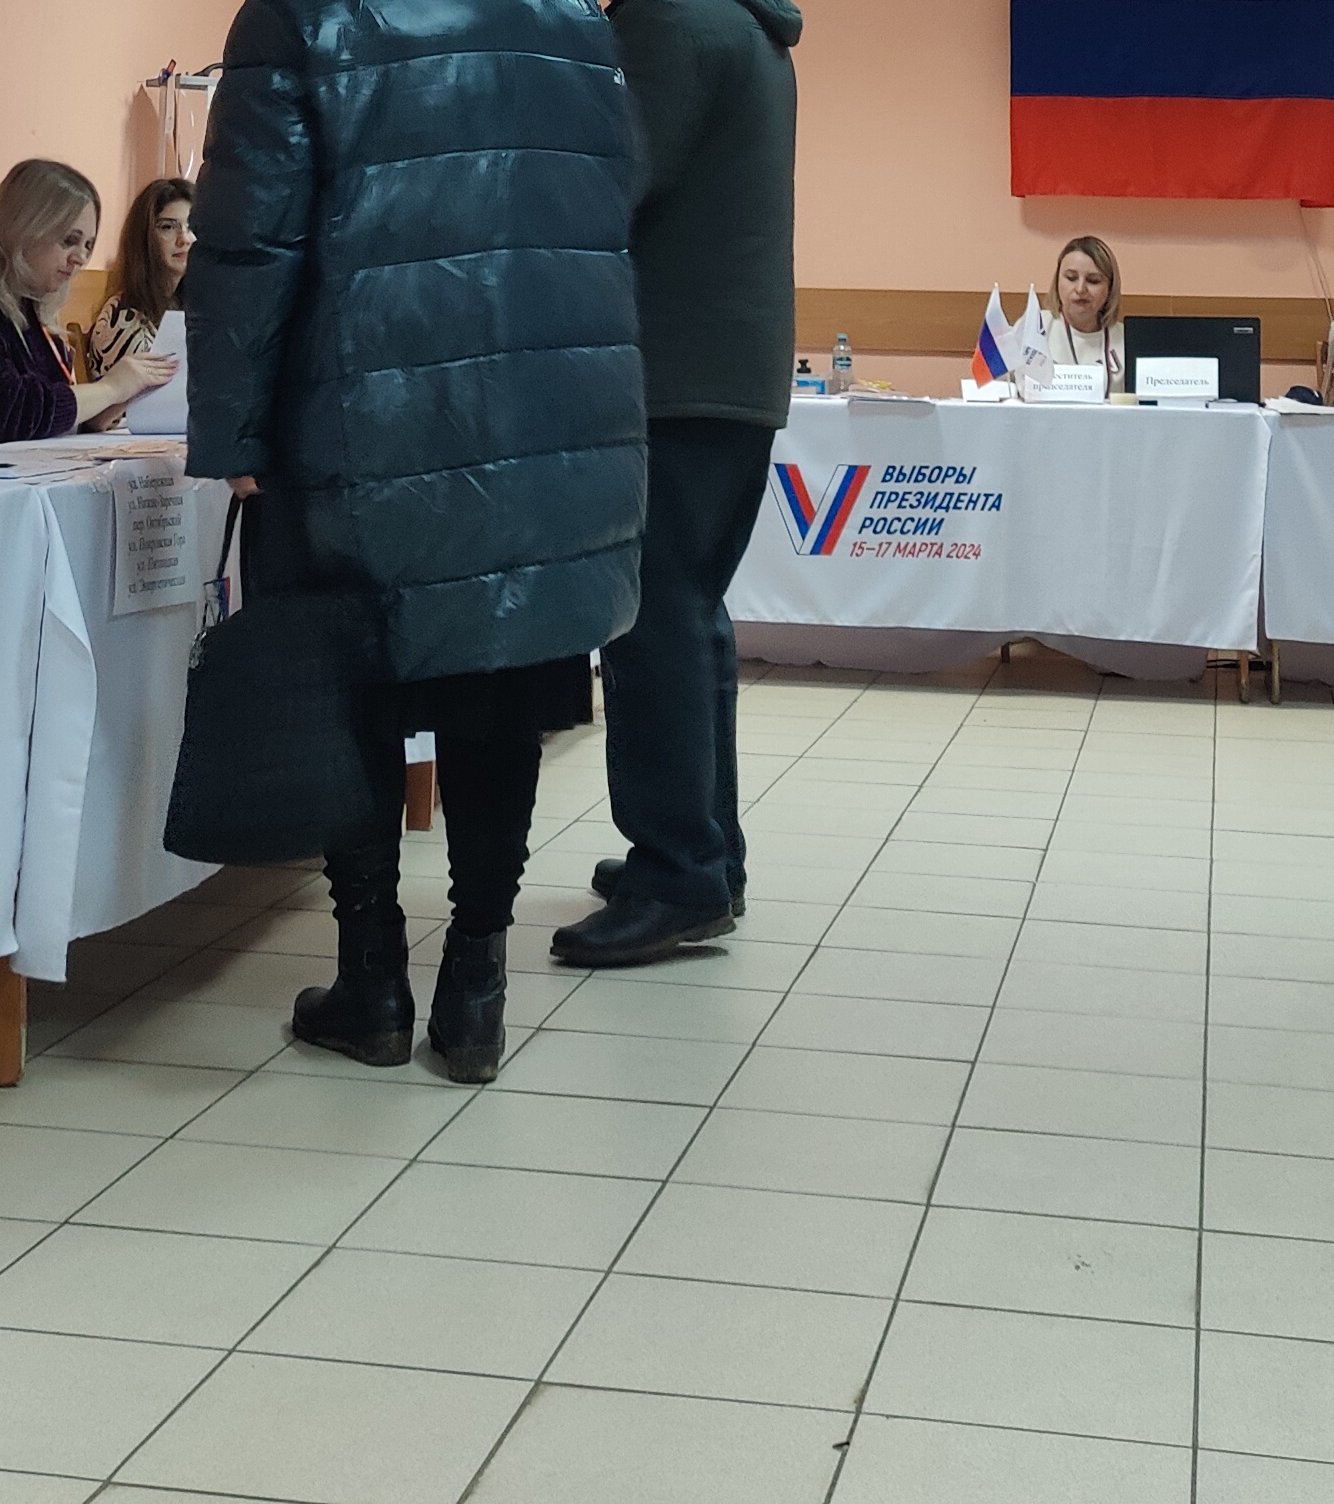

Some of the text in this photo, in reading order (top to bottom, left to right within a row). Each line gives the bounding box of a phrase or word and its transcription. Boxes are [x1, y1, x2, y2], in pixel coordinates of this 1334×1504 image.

[1145, 376, 1210, 388] Председатель
[880, 465, 977, 485] ВЫБОРЫ
[869, 490, 1003, 513] ПРЕЗИДЕНТА
[858, 516, 945, 536] РОССИИ
[892, 542, 943, 559] МАРТА
[945, 543, 982, 560] 2024
